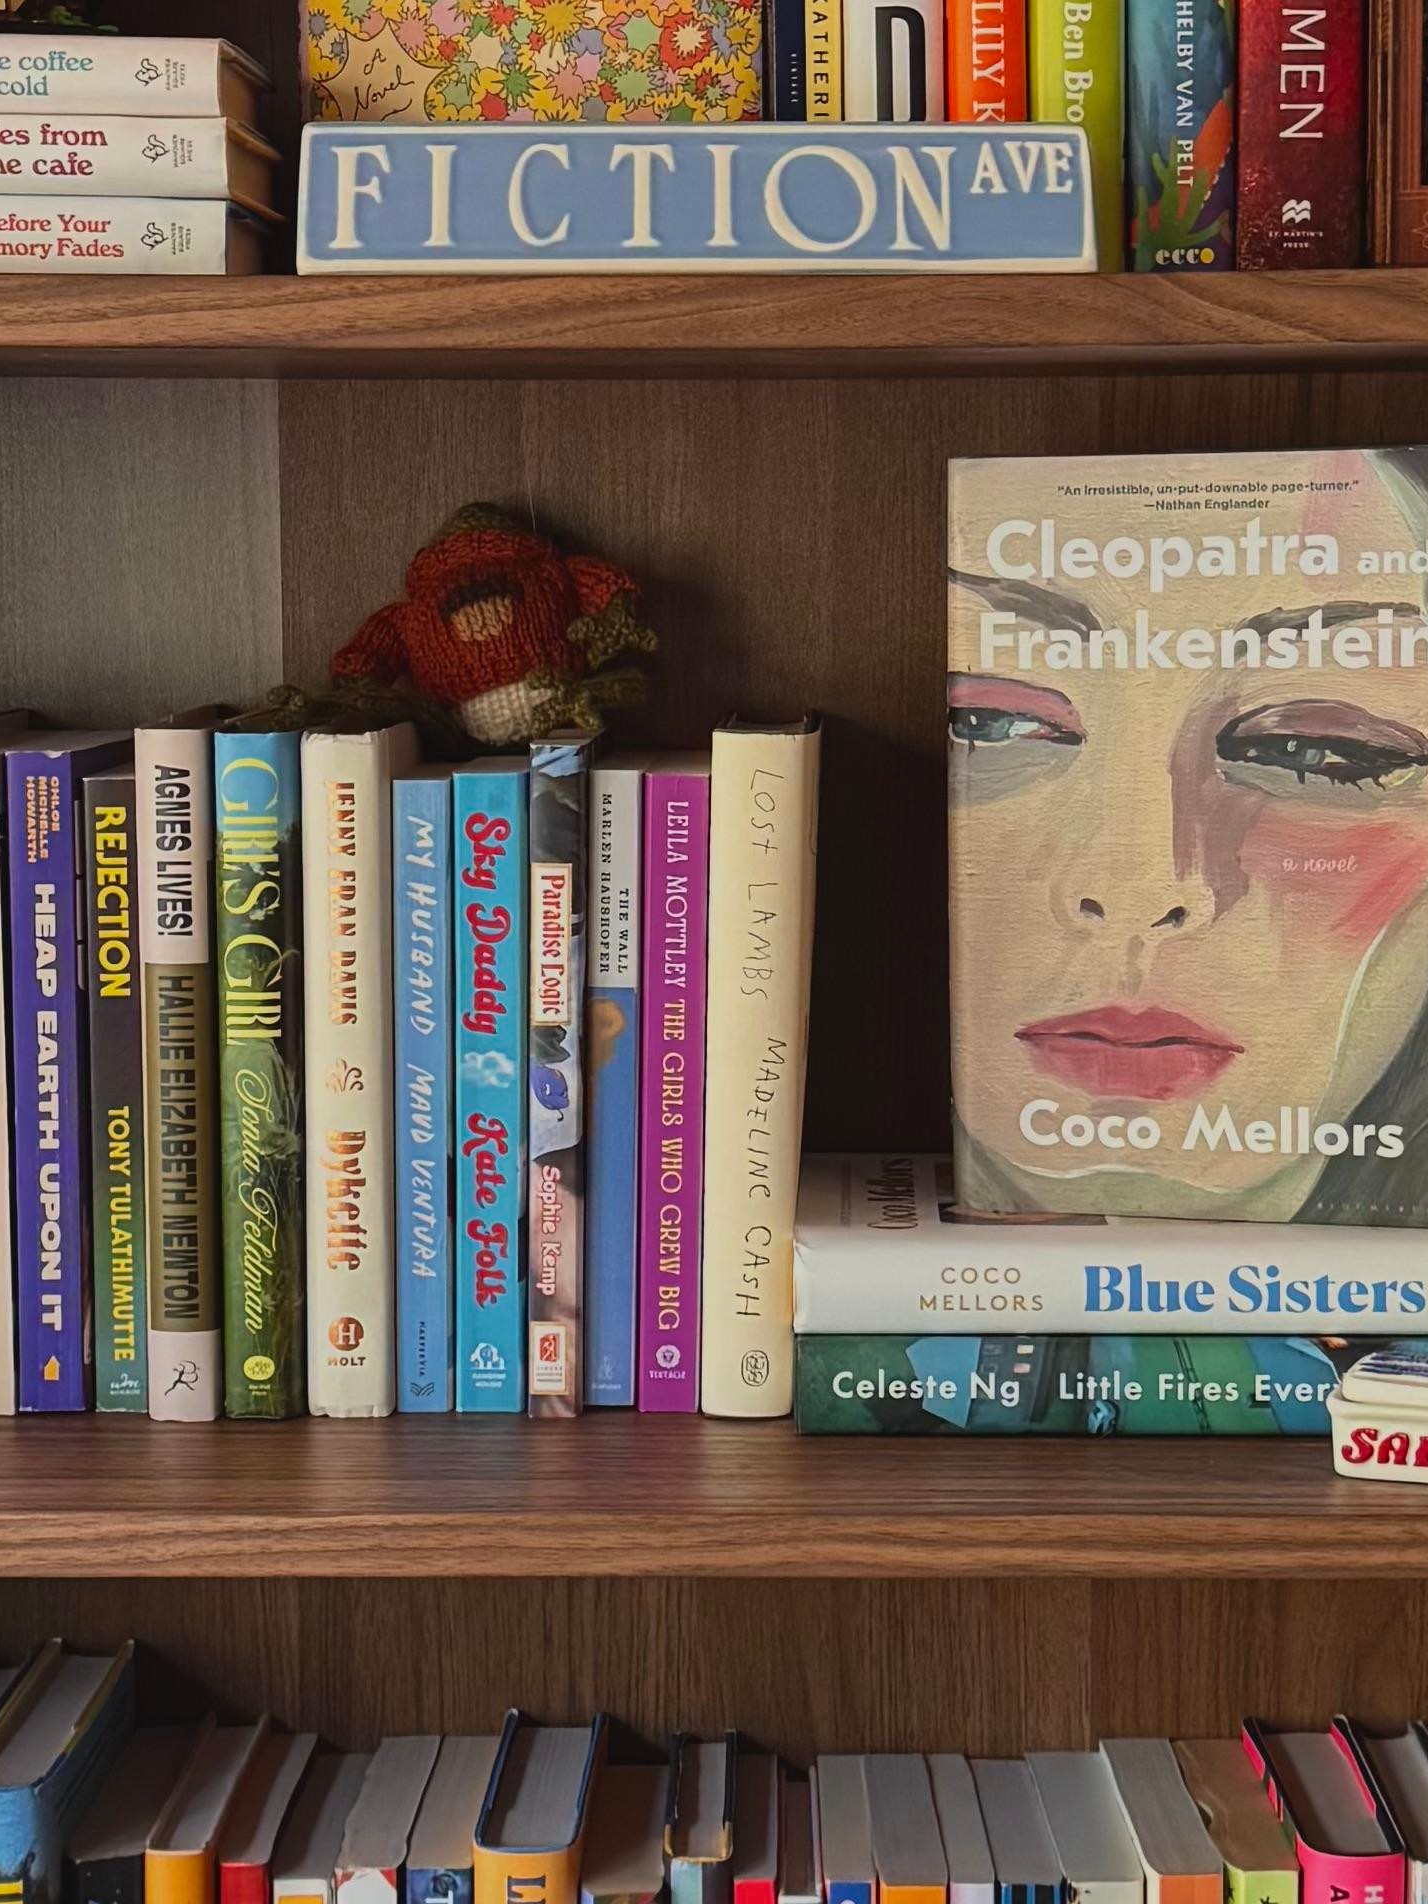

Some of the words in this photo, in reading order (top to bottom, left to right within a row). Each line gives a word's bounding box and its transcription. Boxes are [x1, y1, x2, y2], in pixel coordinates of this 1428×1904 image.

[19, 51, 94, 73] coffee
[328, 141, 975, 253] FICTION
[971, 142, 1075, 196] AVE
[1205, 498, 1270, 511] Englander
[986, 516, 1339, 592] Cleopatra
[750, 768, 784, 856] LOST
[94, 806, 132, 998] REJECTION
[746, 882, 776, 1001] LAMBS
[105, 1106, 128, 1157] TONY
[746, 1036, 790, 1200] MADELINE
[1017, 1098, 1161, 1152] Coco
[1182, 1105, 1406, 1160] Mellors
[108, 1164, 136, 1362] TULATHIMUTTE
[736, 1225, 772, 1318] CASH
[940, 1267, 1022, 1285] COCO
[1084, 1264, 1218, 1314] Blue
[1227, 1262, 1427, 1314] Sisters
[919, 1293, 1045, 1312] MELLORS
[831, 1370, 957, 1401] Celeste
[969, 1371, 1021, 1407] Ng
[1059, 1371, 1143, 1402] Little
[1157, 1371, 1239, 1402] Fires
